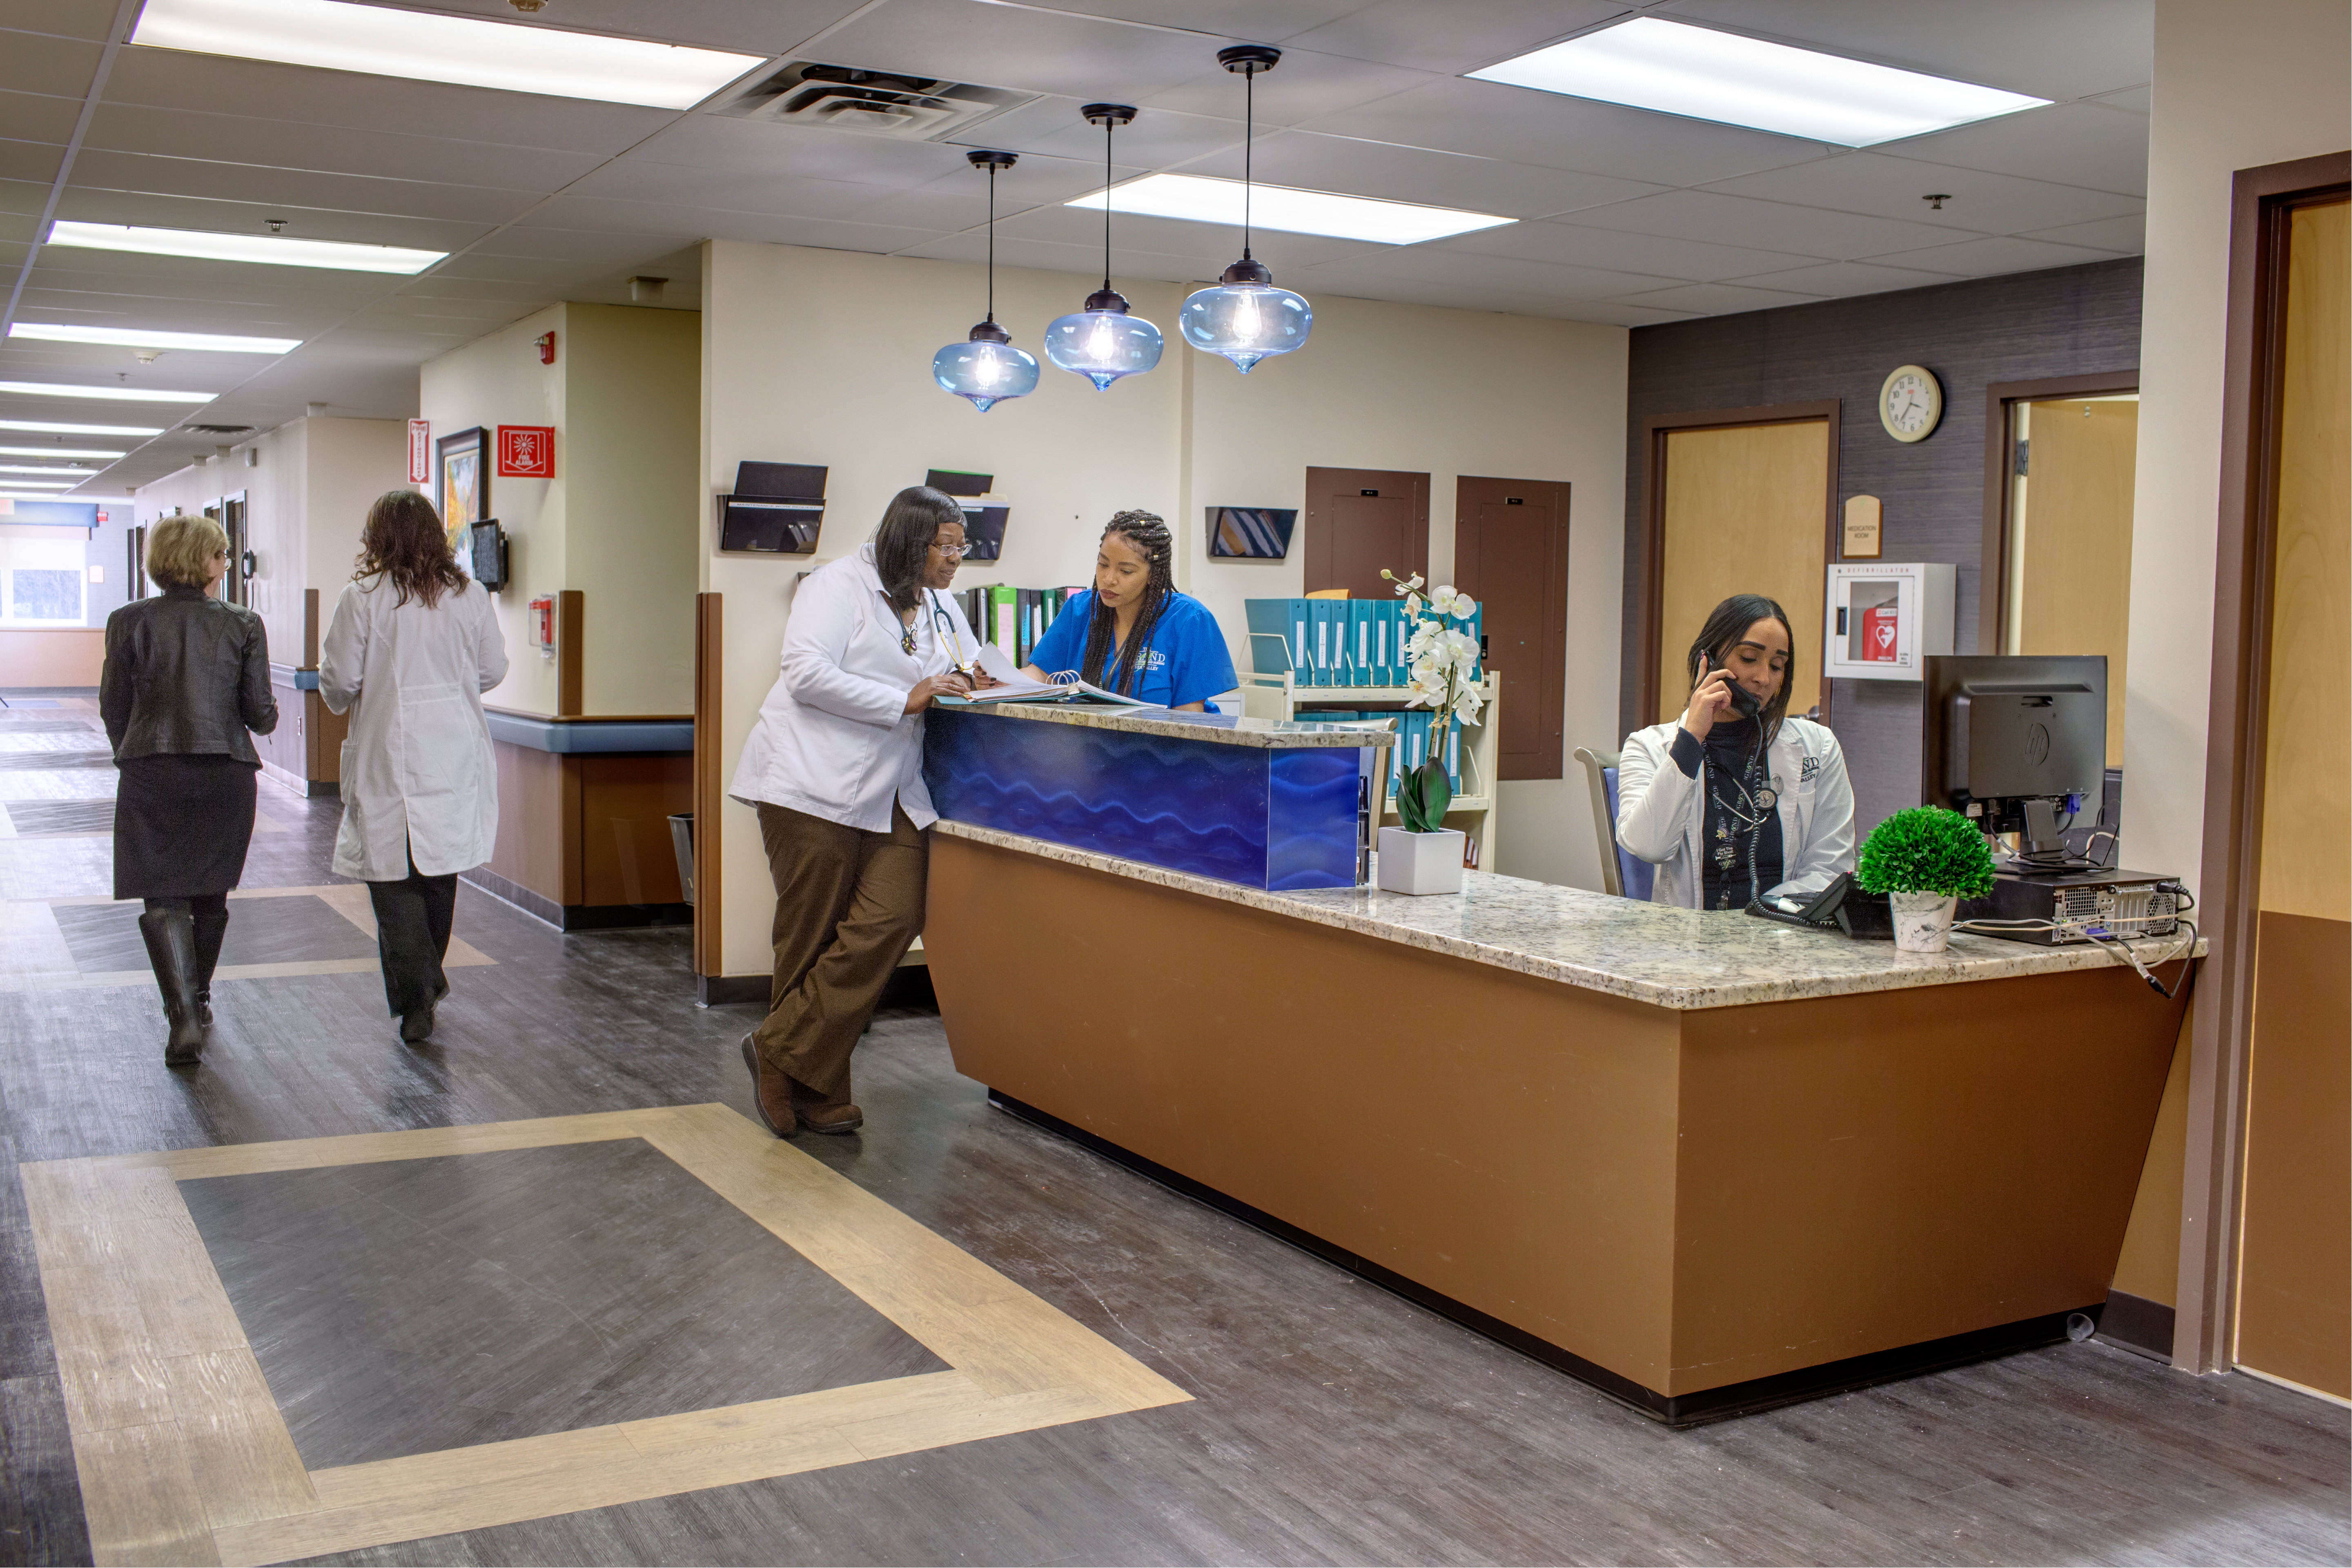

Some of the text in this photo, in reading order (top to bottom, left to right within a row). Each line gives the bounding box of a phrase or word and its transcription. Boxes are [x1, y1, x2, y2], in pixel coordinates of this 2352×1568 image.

[1908, 376, 1914, 385] 12
[1893, 390, 1900, 399] 10
[1910, 423, 1915, 432] 6
